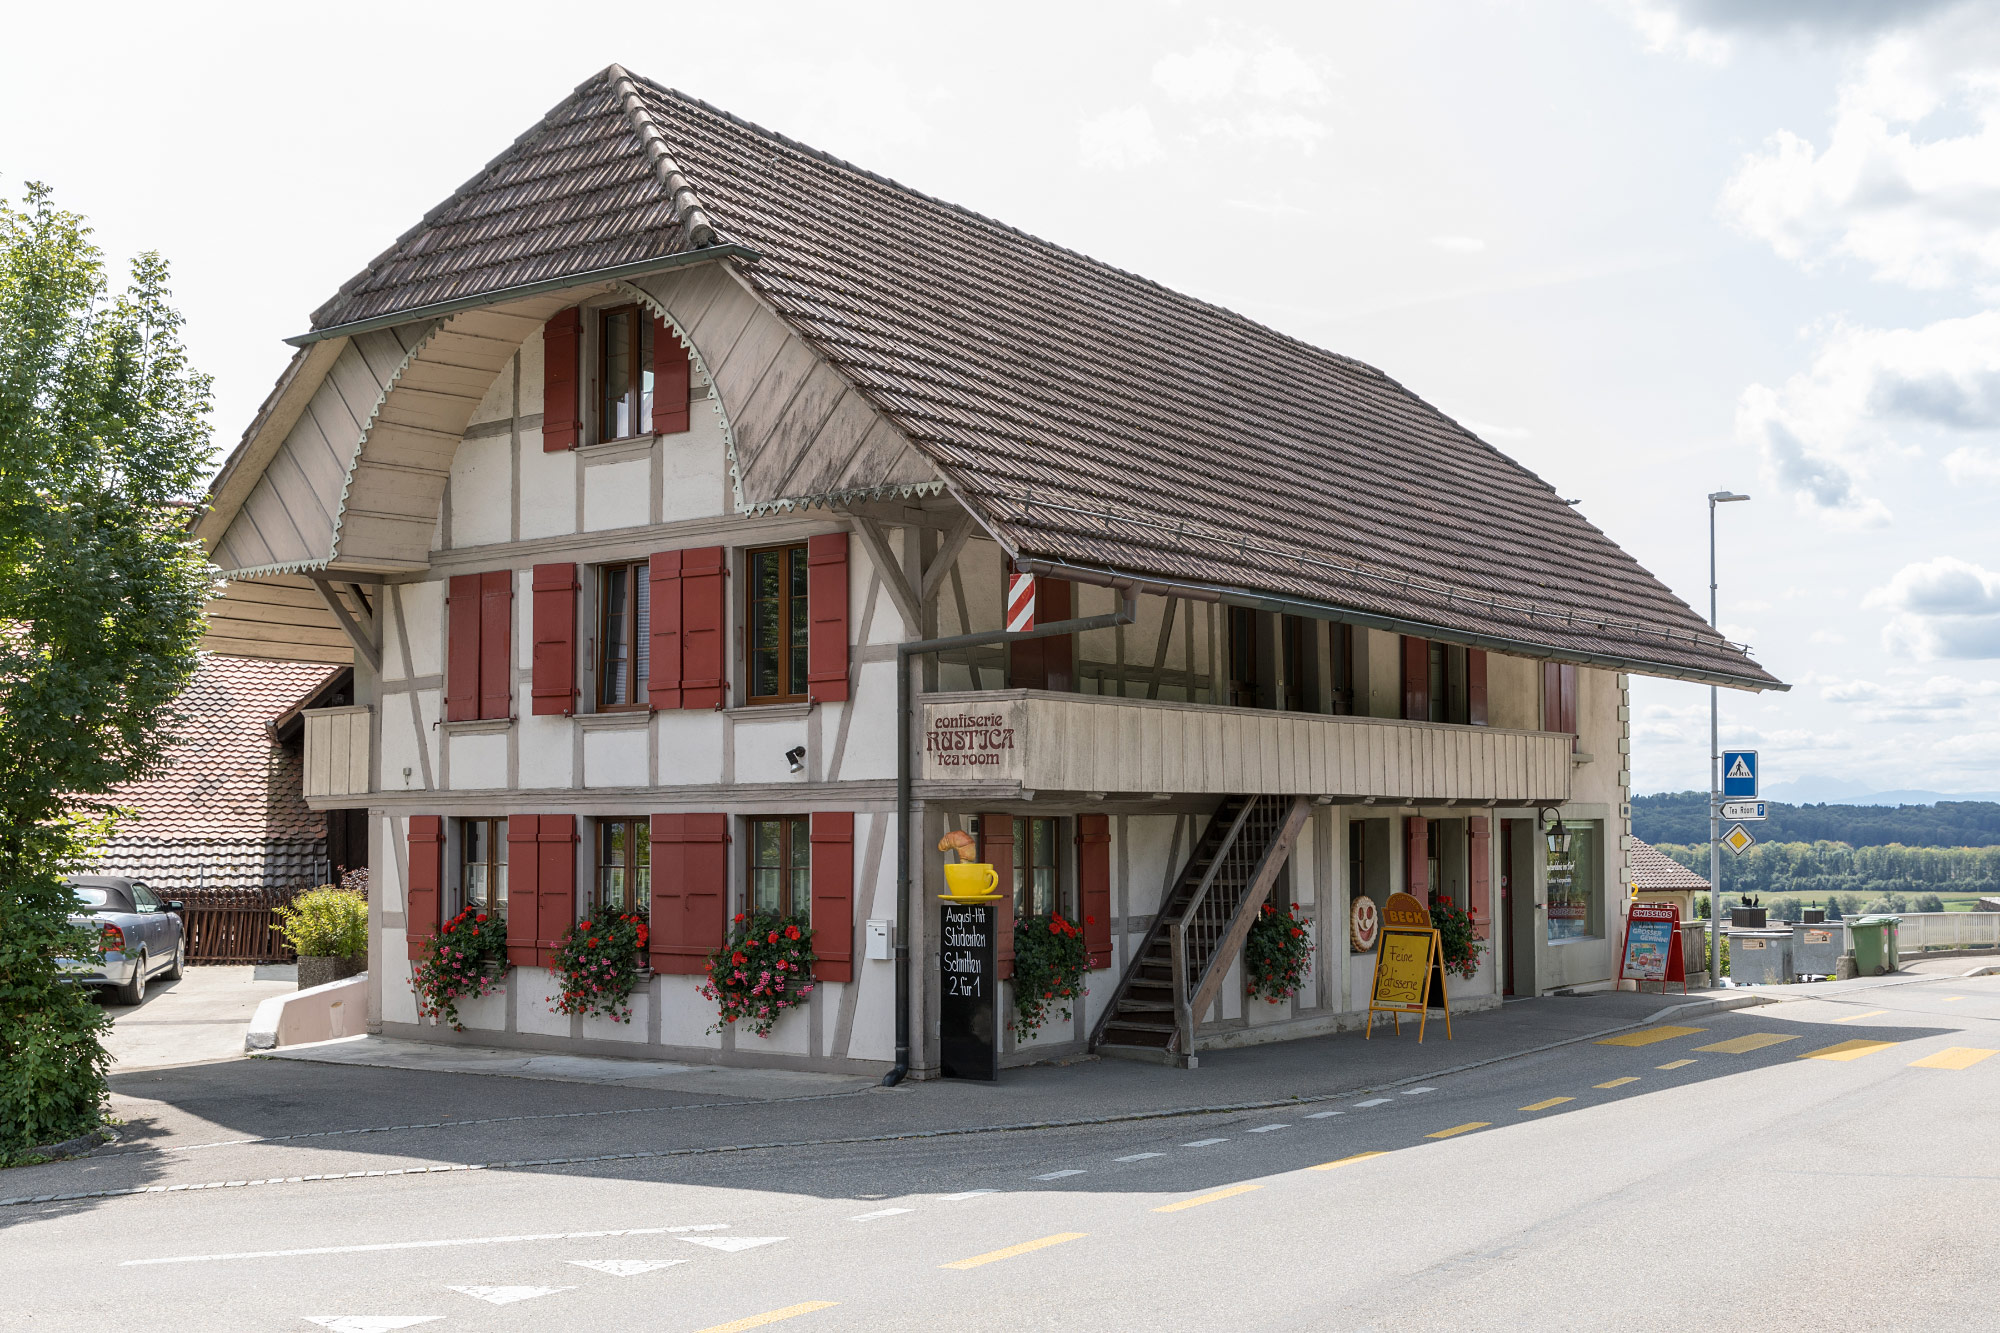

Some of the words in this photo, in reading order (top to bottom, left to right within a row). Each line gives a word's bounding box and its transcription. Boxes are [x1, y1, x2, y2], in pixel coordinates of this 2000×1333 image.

[935, 713, 1003, 729] confiserie
[926, 729, 1015, 751] RUSTICA
[1729, 806, 1738, 814] Tea
[1740, 806, 1755, 814] Room
[945, 907, 986, 929] August-Hit
[1390, 910, 1424, 924] BECK
[1633, 910, 1672, 918] SWISSLOS
[944, 926, 986, 947] Studenten
[1632, 928, 1662, 936] GROSSER
[1640, 935, 1668, 943] GEWINN!
[944, 951, 981, 973] Schnitten
[1389, 945, 1414, 962] Feine
[1378, 964, 1418, 990] Patisserie
[949, 976, 959, 996] 2
[960, 976, 973, 996] für
[974, 976, 981, 997] 1
